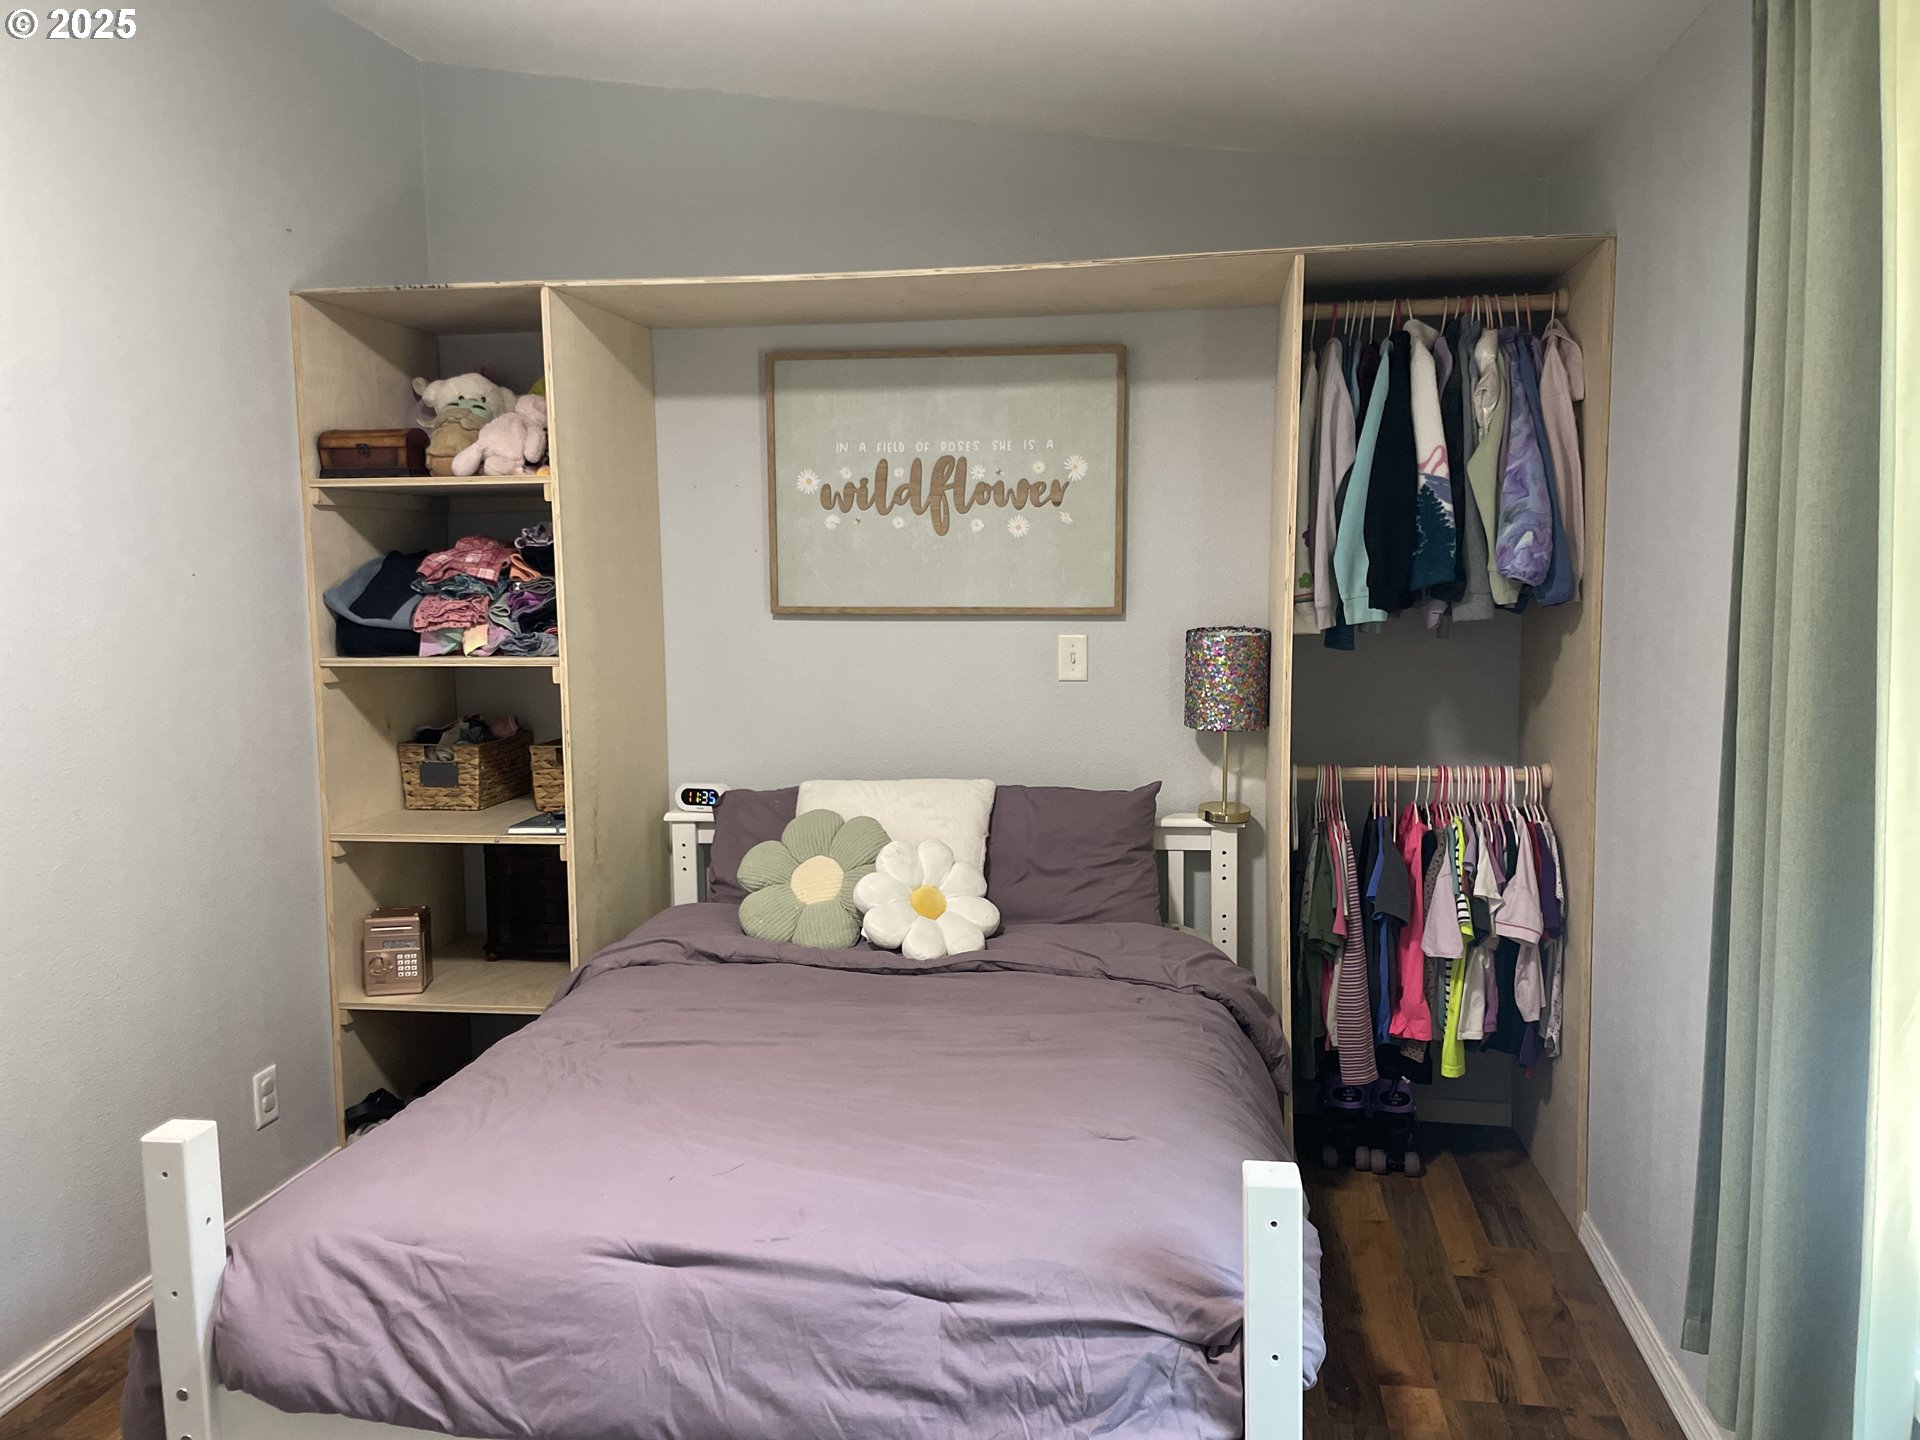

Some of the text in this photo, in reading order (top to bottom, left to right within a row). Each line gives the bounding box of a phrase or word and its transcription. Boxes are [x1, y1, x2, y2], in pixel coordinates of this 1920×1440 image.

[835, 439, 1054, 453] IN A FIELD OF ROSES SHE IS A
[820, 455, 1070, 536] wildflower
[689, 791, 716, 804] 11:35
